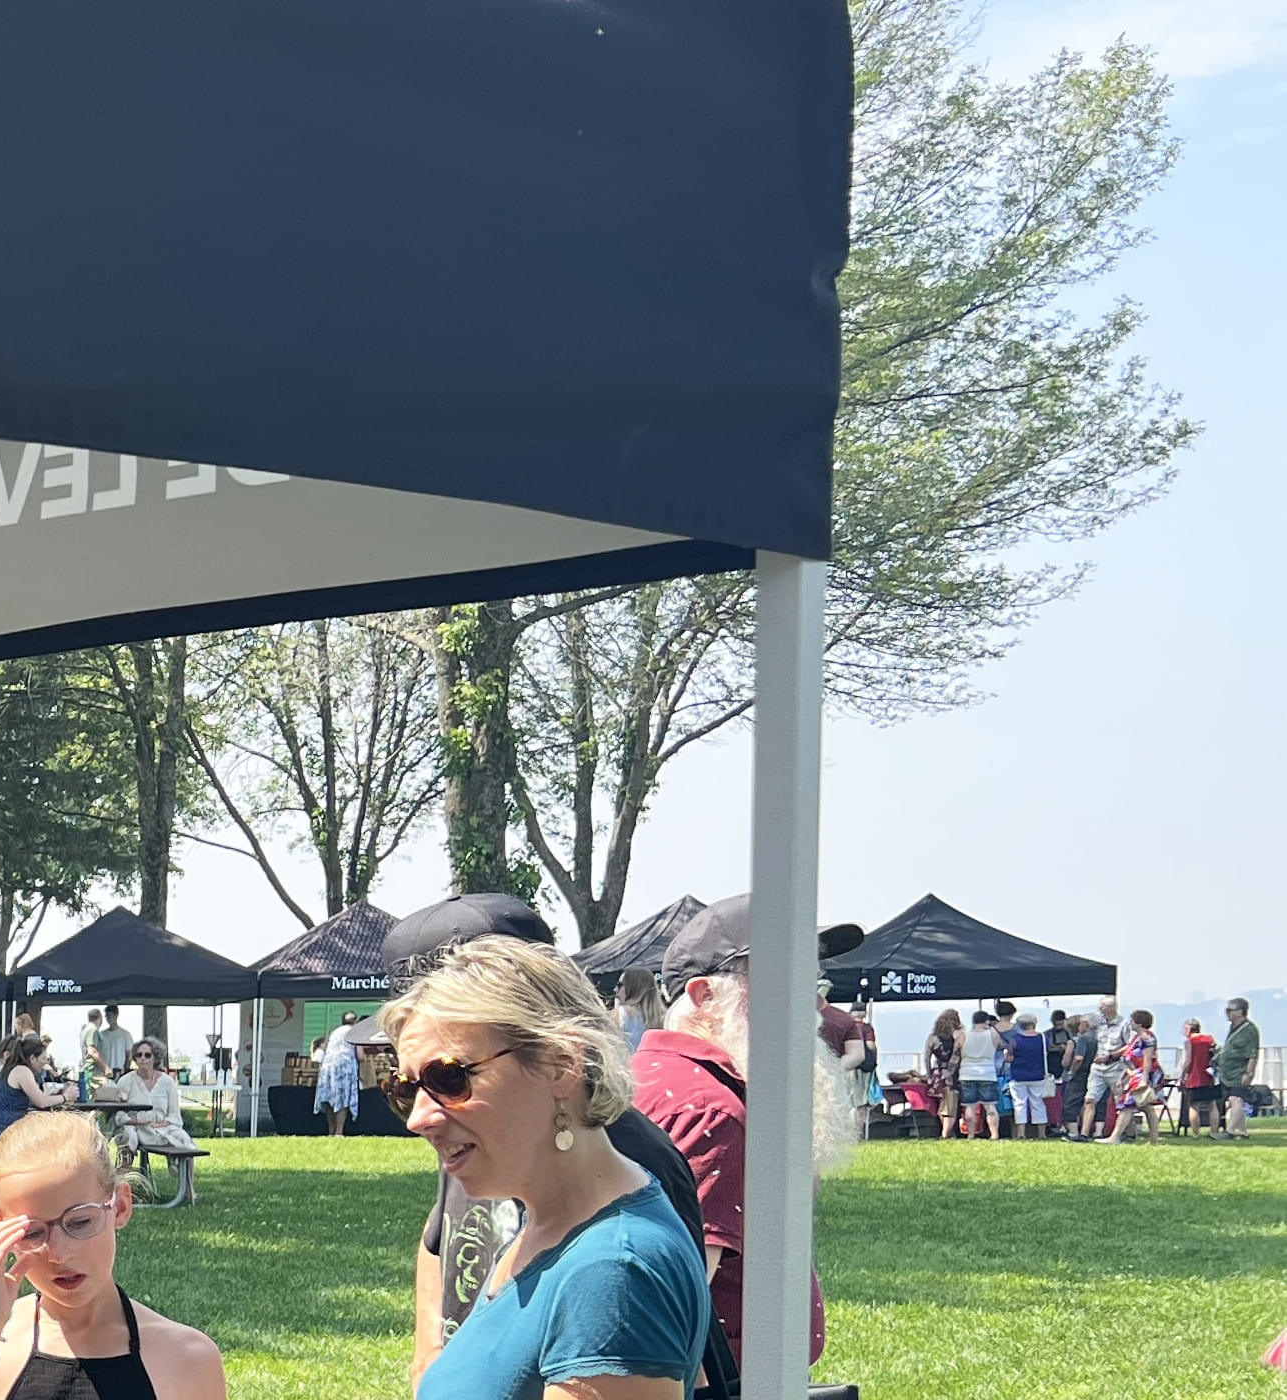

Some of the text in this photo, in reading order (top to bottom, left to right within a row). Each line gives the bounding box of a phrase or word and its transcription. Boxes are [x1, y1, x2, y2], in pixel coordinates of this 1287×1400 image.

[331, 975, 390, 990] Marché
[907, 973, 936, 983] Patro
[907, 983, 936, 994] Lévis
